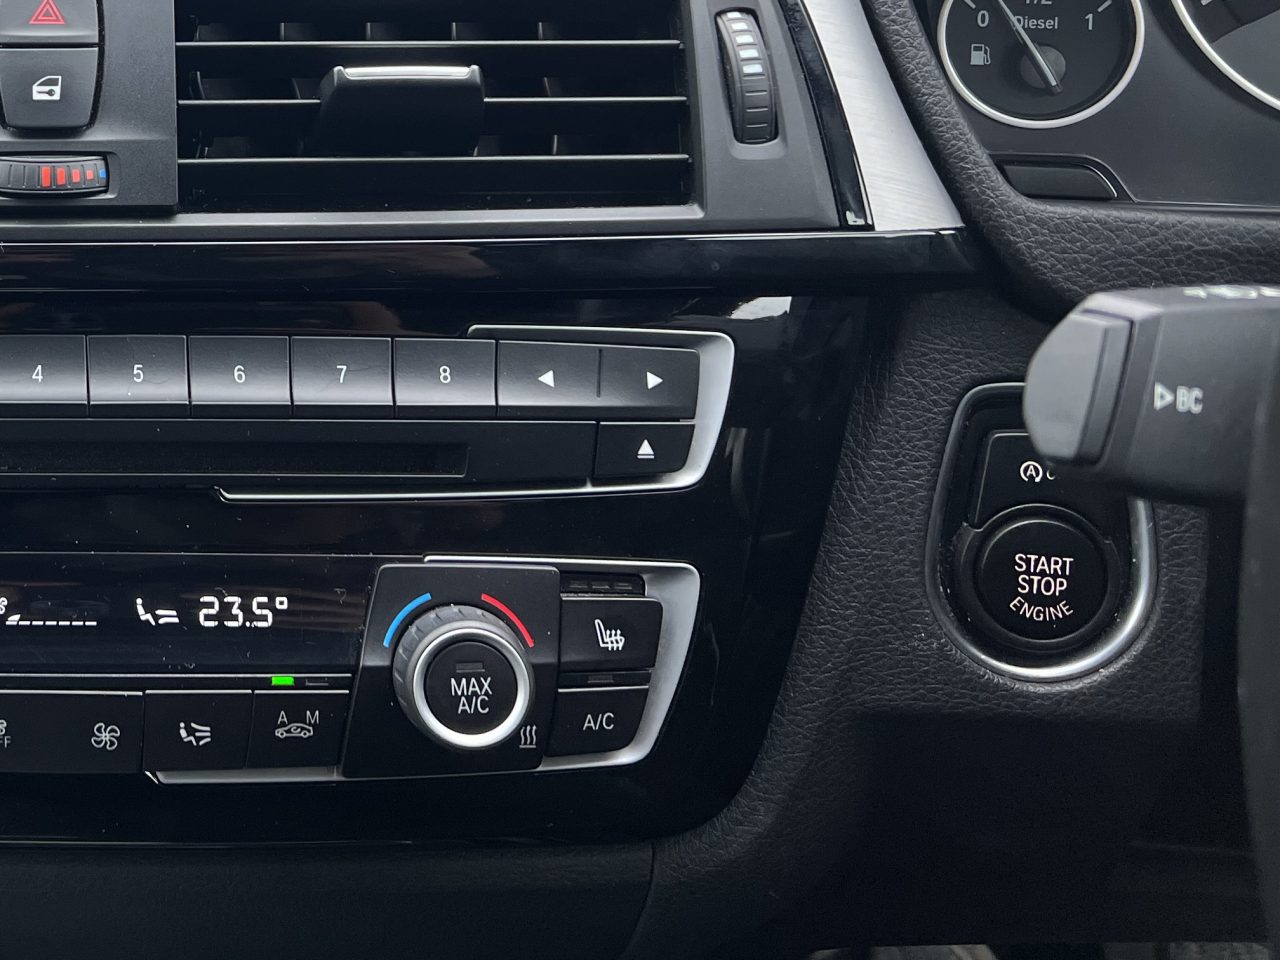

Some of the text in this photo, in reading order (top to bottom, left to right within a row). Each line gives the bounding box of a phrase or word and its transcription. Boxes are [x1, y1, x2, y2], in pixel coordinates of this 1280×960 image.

[977, 10, 990, 28] 0
[1014, 15, 1059, 30] Diesel
[1084, 13, 1093, 31] 1
[31, 365, 44, 383] 4
[133, 364, 144, 382] 5
[233, 365, 246, 383] 6
[336, 365, 348, 383] 7
[439, 365, 451, 383] 8
[1014, 553, 1074, 576] START
[1017, 574, 1068, 596] STOP
[1009, 596, 1074, 621] ENGINE
[450, 676, 493, 696] MAX
[457, 695, 490, 714] A/C
[278, 709, 319, 724] A M
[582, 712, 615, 731] A/C
